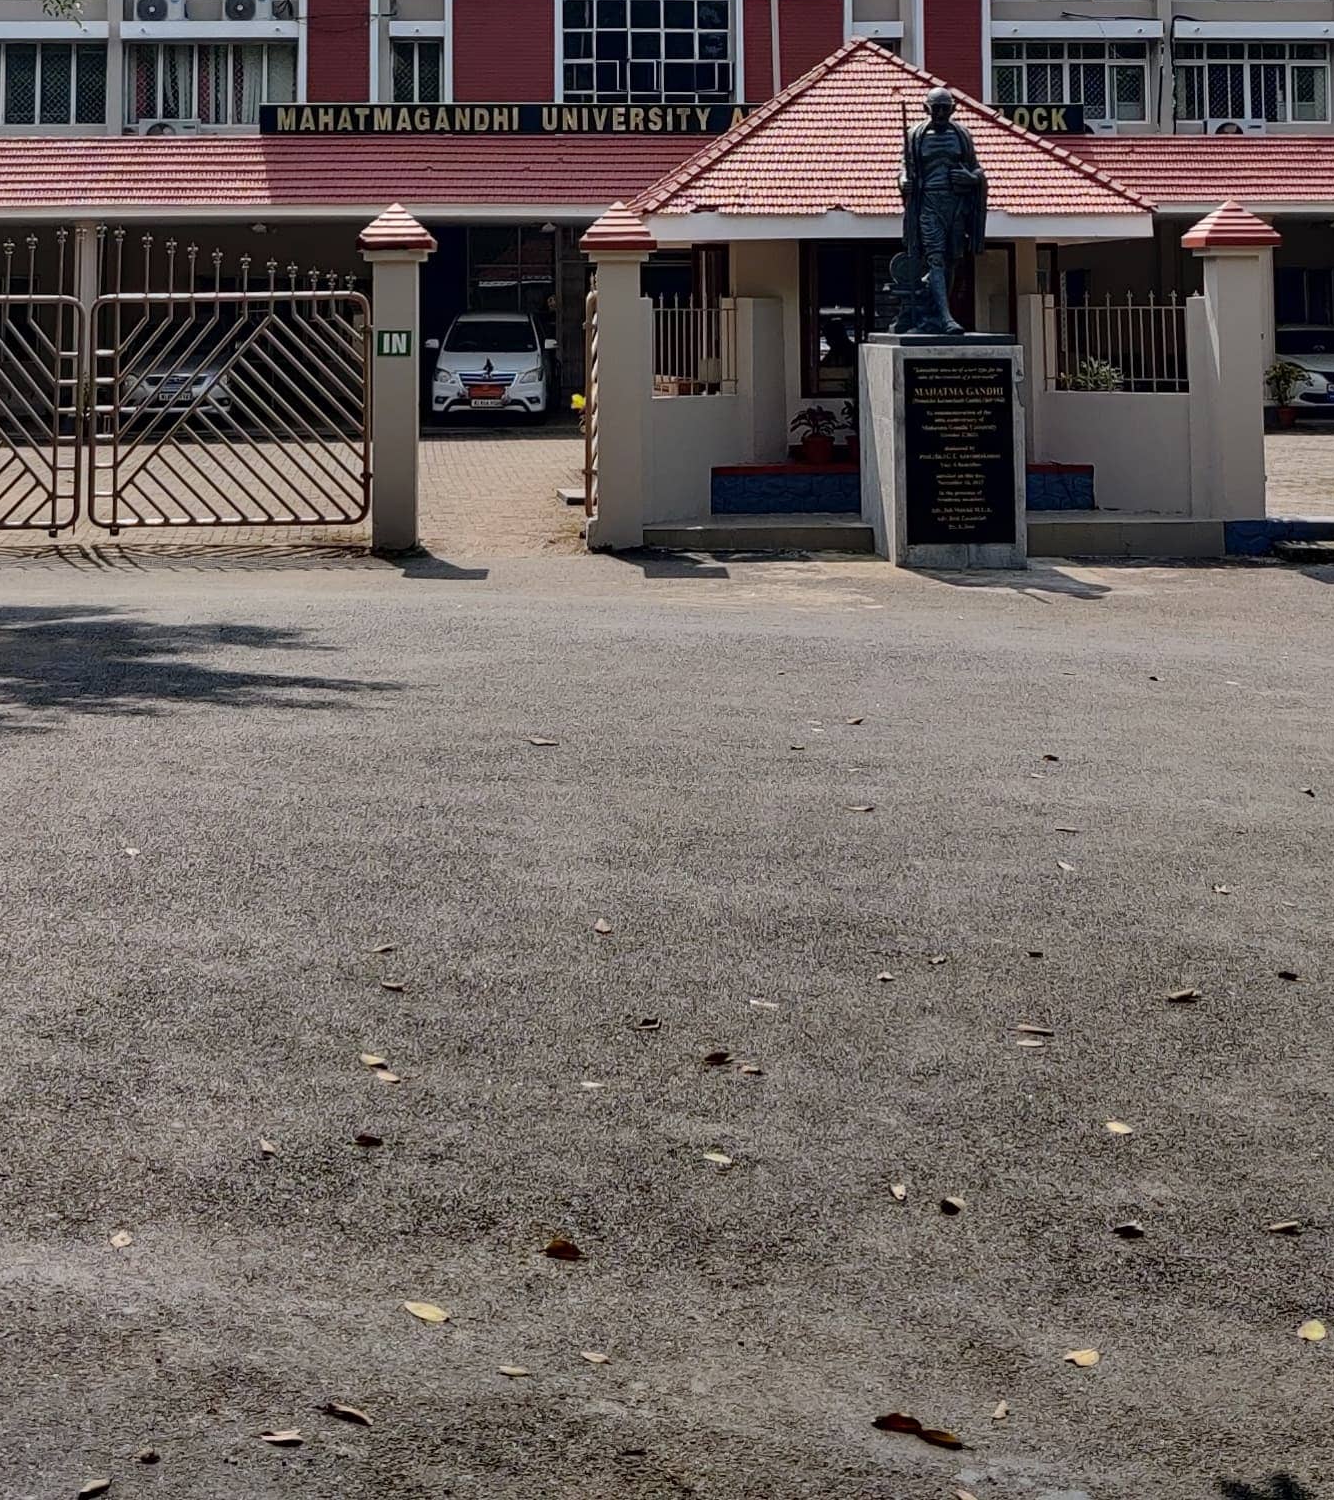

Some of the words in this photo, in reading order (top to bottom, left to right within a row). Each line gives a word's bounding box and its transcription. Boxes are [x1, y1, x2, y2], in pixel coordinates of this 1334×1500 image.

[276, 106, 519, 132] MAHATMAGANDHI
[542, 106, 710, 132] UNIVERSITY
[998, 107, 1068, 131] OCK
[383, 333, 407, 354] IN
[914, 387, 964, 396] MAHATMA
[966, 386, 1004, 396] GANDHI
